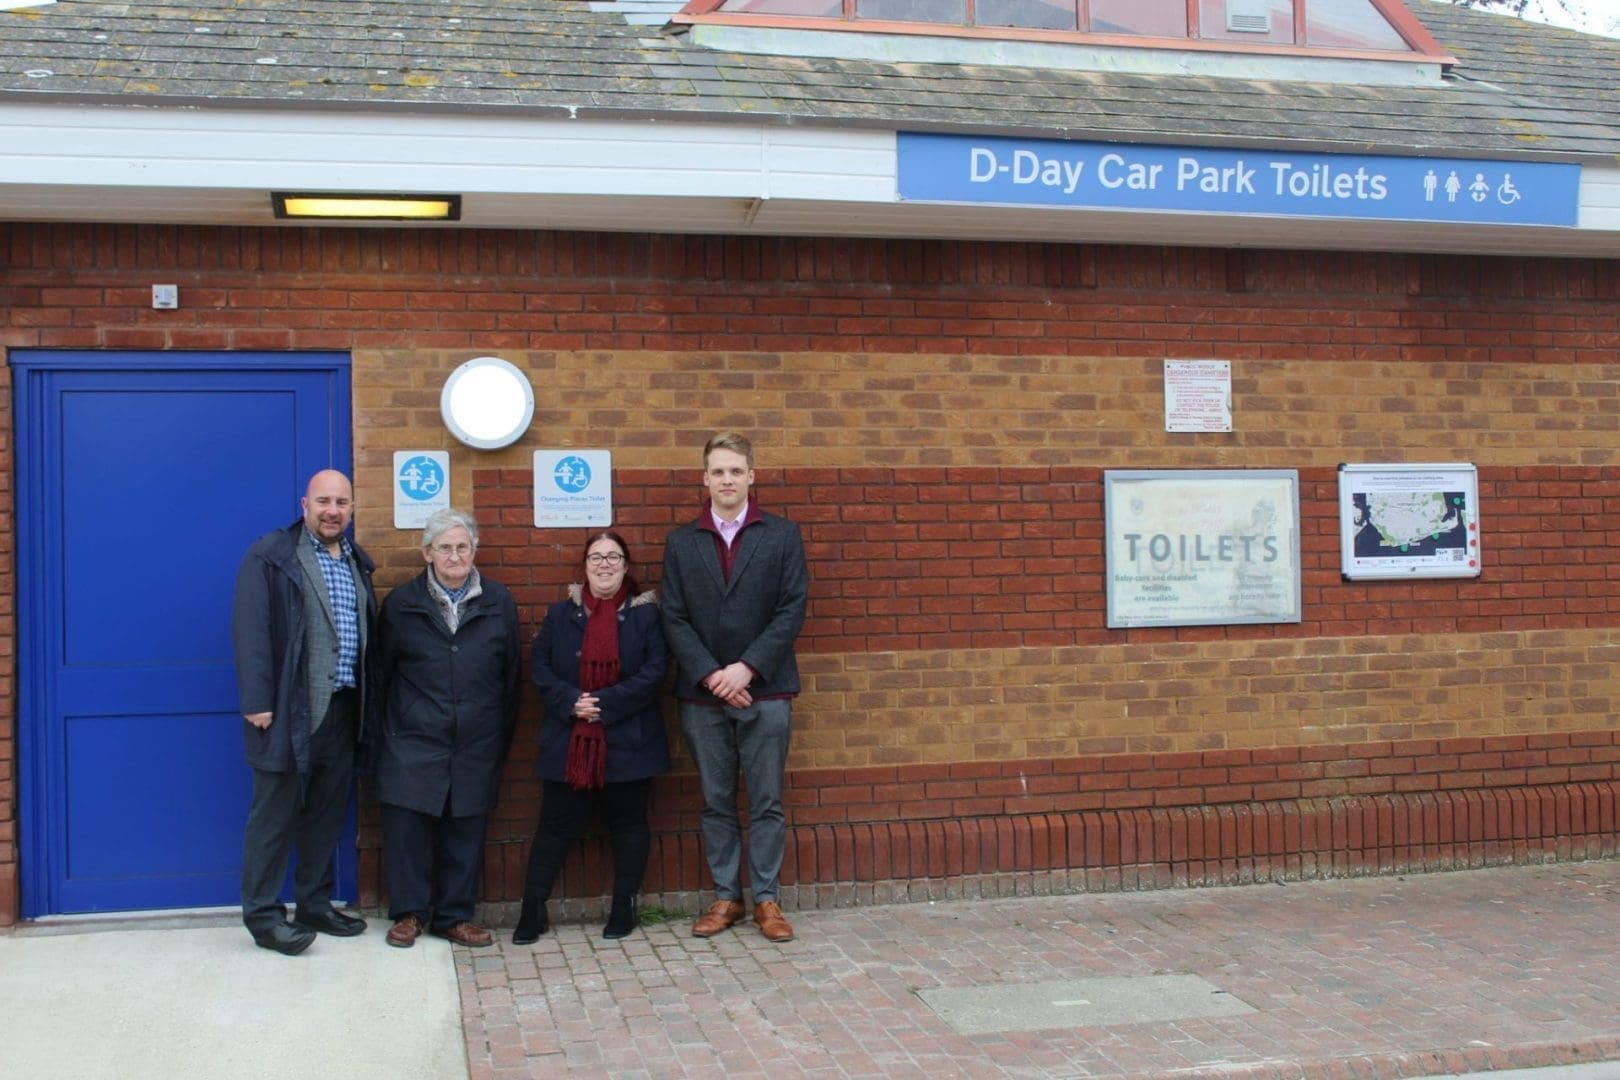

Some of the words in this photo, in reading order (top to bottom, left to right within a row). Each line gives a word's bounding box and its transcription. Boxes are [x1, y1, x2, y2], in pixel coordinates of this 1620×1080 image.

[968, 147, 1083, 196] D-Day
[1098, 153, 1163, 192] Car
[1176, 157, 1257, 195] Park
[1269, 161, 1388, 200] Toilets
[1123, 533, 1278, 563] TOILETS
